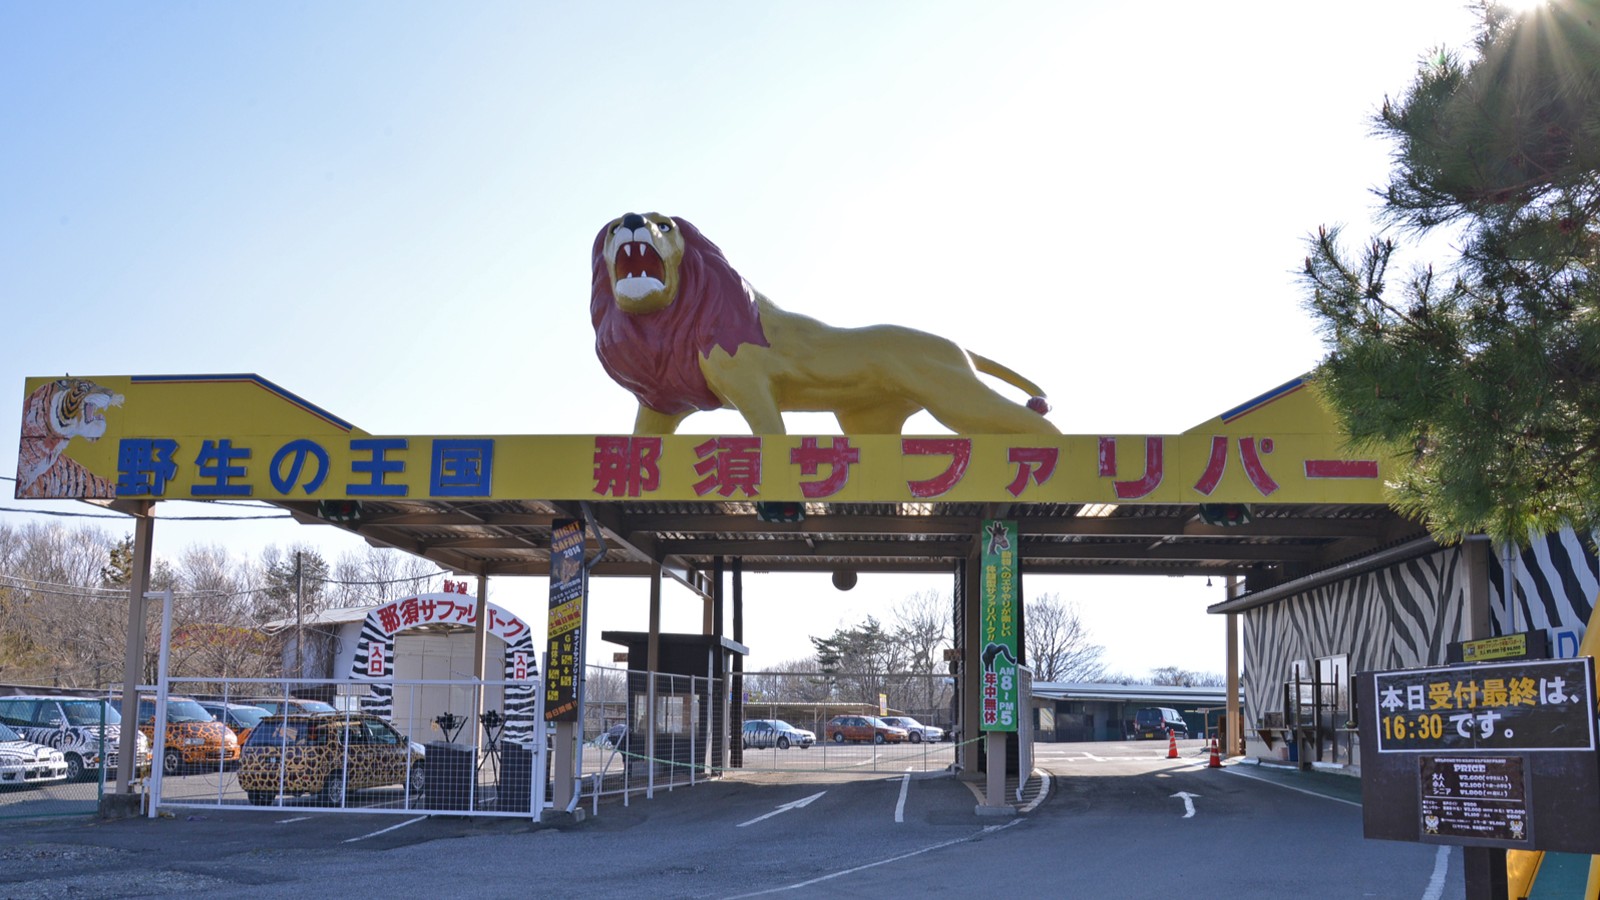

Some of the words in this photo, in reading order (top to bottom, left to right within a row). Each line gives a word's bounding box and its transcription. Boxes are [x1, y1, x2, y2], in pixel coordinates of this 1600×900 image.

[115, 438, 495, 497] 野生の王国
[553, 520, 581, 540] NIGHT
[552, 533, 584, 553] SAFARI
[563, 545, 581, 558] 2014
[444, 579, 468, 595] 歓迎
[376, 597, 524, 637] 那須サファリパーク
[371, 646, 382, 672] 入口
[516, 656, 526, 679] 入口
[999, 667, 1015, 675] AM
[984, 673, 997, 724] 年中無休
[1380, 676, 1580, 712] 本日受付最終は、
[999, 702, 1014, 710] PM
[1432, 773, 1445, 781] 大人
[1453, 764, 1486, 772] PRICE
